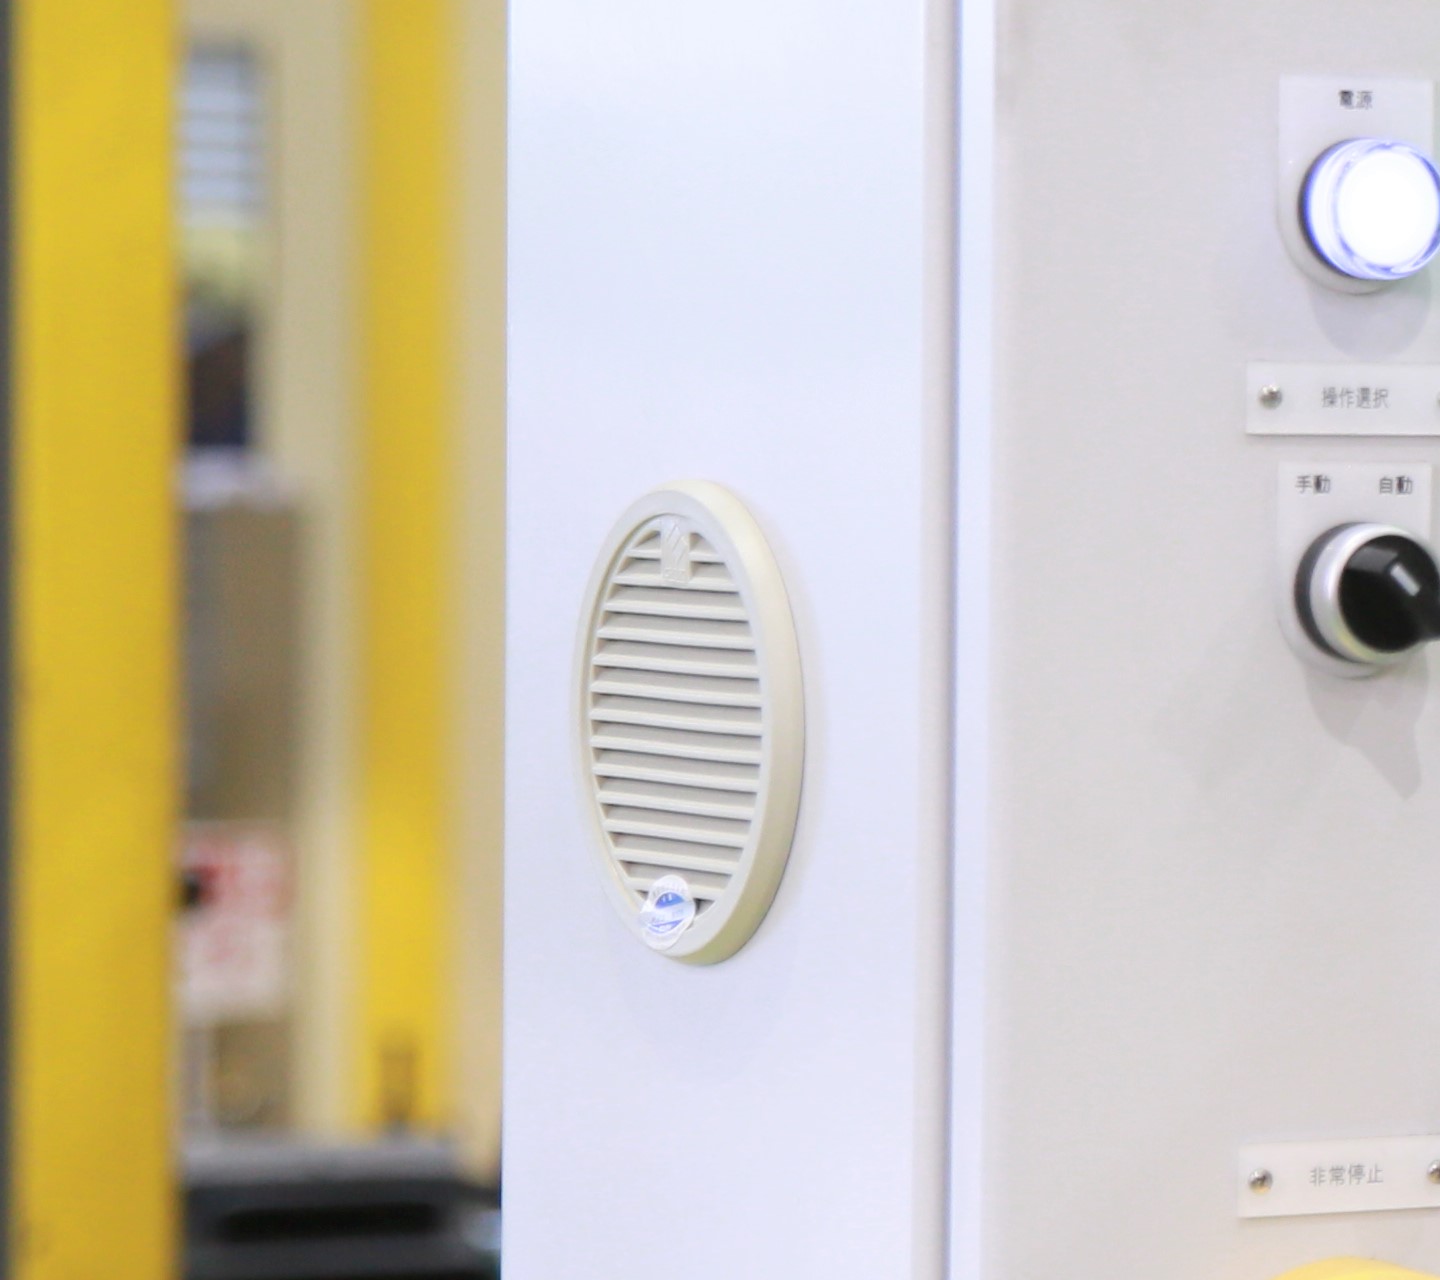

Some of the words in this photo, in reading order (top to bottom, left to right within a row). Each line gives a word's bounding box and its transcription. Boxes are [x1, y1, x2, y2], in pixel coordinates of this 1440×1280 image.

[1339, 89, 1373, 111] 電源
[1321, 387, 1389, 409] 操作選択
[1295, 474, 1331, 495] 手動
[1378, 475, 1413, 495] 自動
[1309, 1163, 1384, 1187] 非常停止
